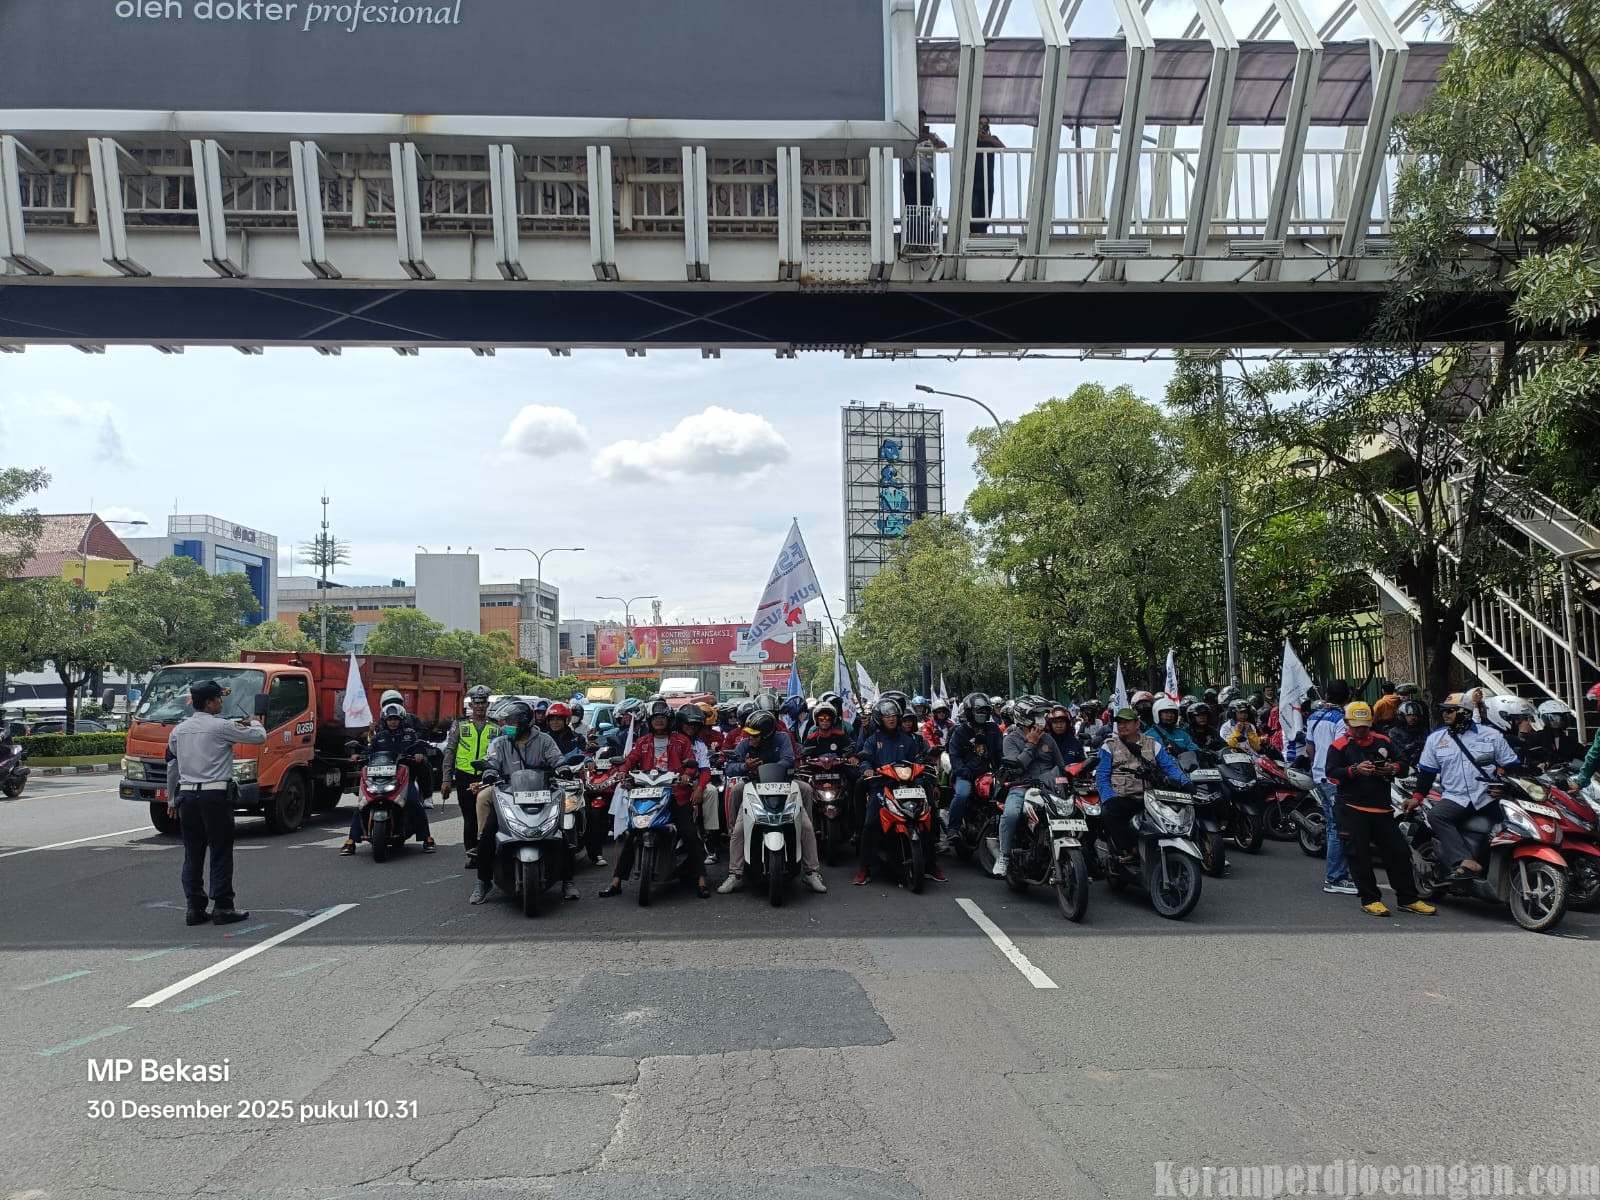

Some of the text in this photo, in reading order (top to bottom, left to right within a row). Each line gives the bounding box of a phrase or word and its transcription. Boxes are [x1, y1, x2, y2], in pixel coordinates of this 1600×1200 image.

[115, 0, 461, 32] oleh dokter profesional
[296, 722, 314, 735] 0359
